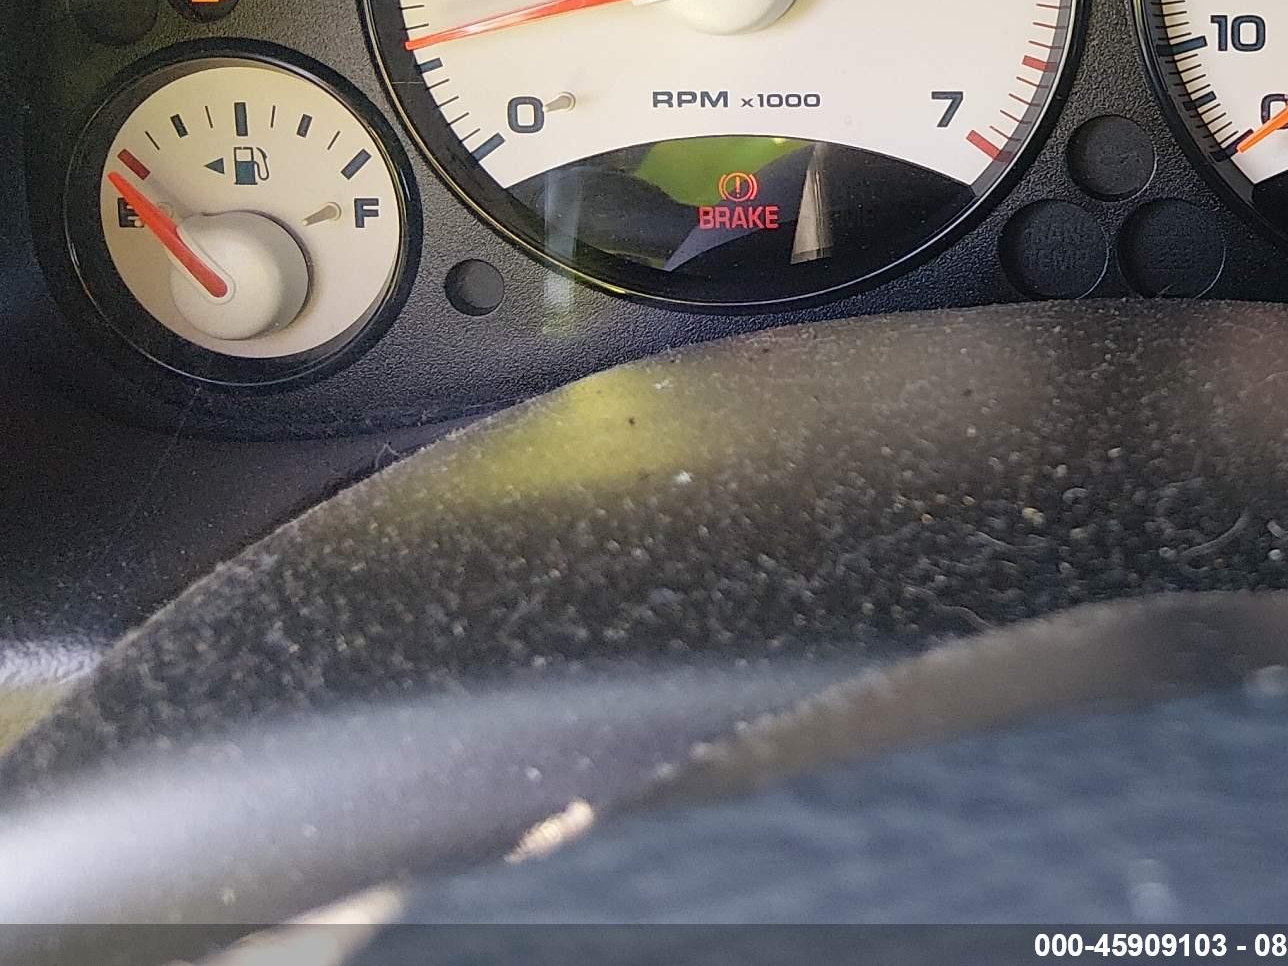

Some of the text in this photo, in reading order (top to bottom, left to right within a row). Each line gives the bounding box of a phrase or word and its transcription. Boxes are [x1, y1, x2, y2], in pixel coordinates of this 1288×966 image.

[1210, 15, 1265, 52] 10
[507, 97, 544, 133] 0
[653, 91, 820, 107] RPM x1000
[932, 91, 963, 127] 7
[354, 198, 379, 228] F
[700, 206, 778, 230] BRAKE
